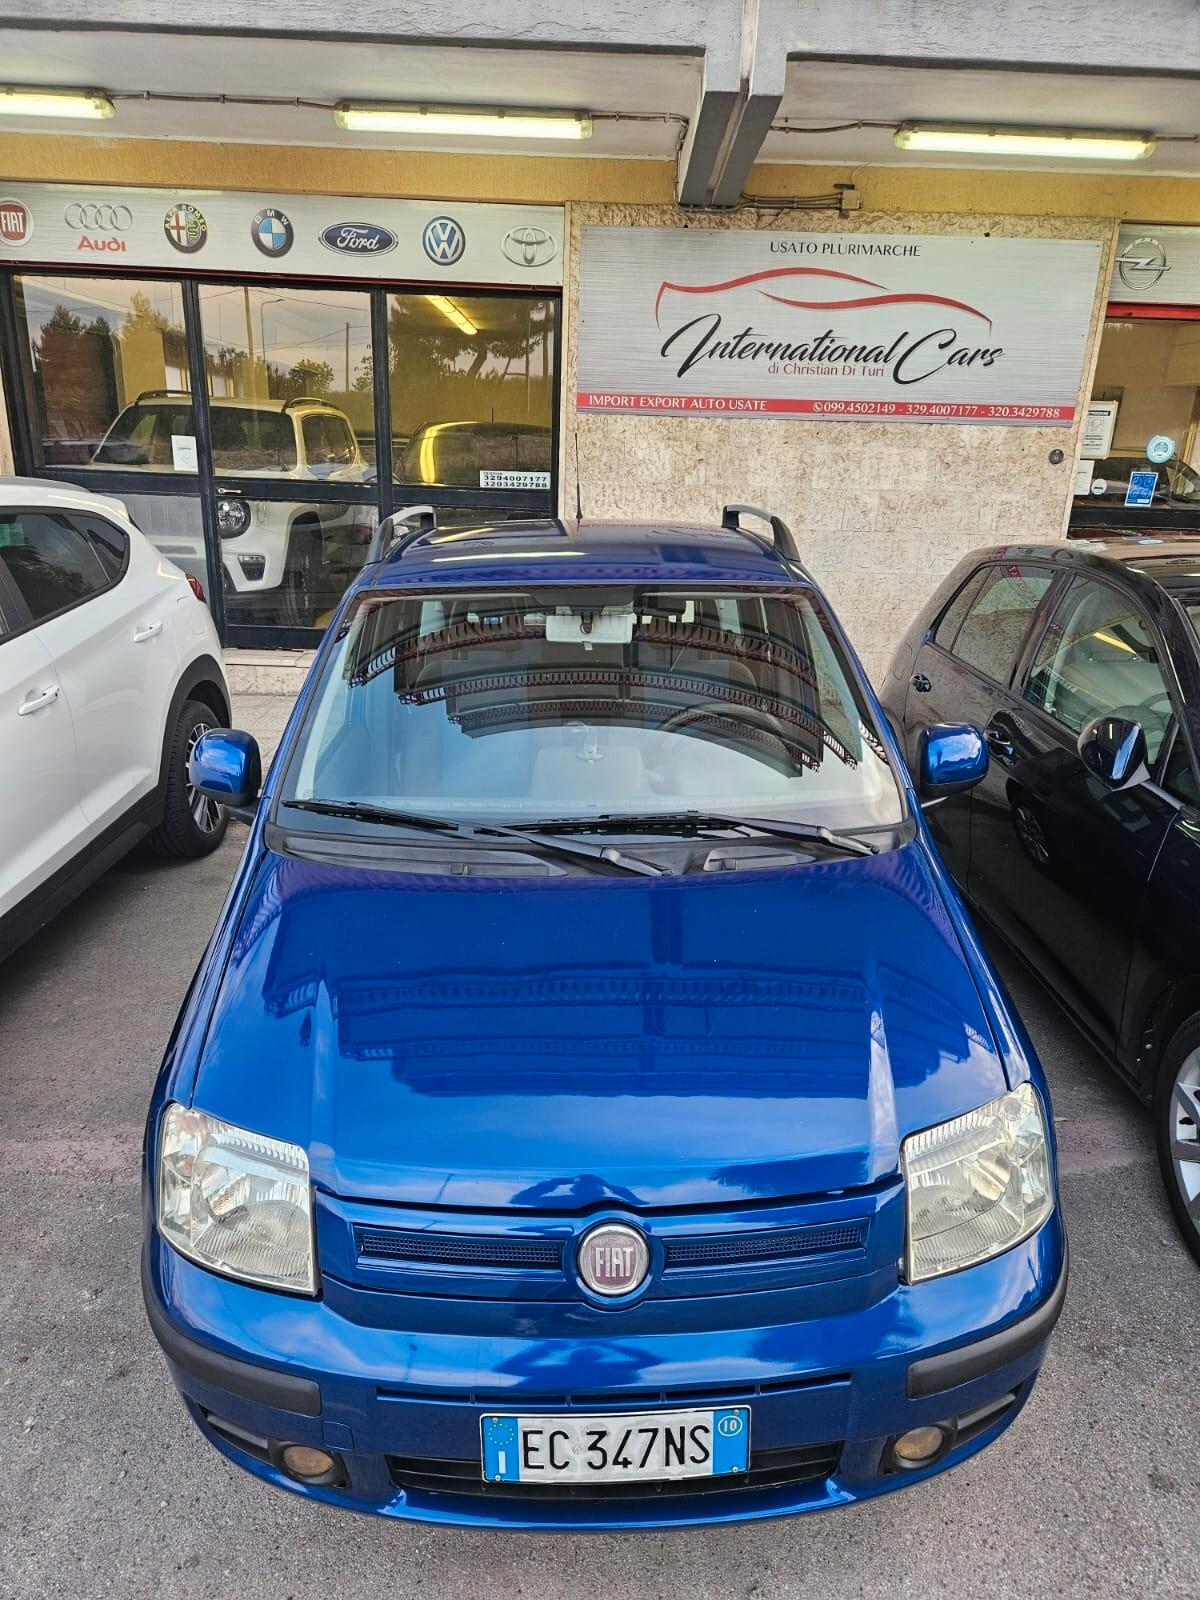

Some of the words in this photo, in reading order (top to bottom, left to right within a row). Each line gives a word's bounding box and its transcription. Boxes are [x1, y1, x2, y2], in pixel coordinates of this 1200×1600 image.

[0, 211, 24, 233] FIAT
[181, 204, 207, 231] ROMEO
[254, 209, 290, 226] BMW
[77, 235, 127, 252] Audi
[337, 227, 380, 250] Ford
[769, 241, 818, 255] USATO
[822, 242, 922, 258] PLURIMARCHE
[661, 313, 911, 379] International
[892, 328, 1006, 386] Cars
[767, 363, 780, 376] di
[783, 363, 838, 377] Christian
[842, 364, 857, 377] Di
[859, 365, 885, 378] Turi
[589, 395, 637, 408] IMPORT
[640, 396, 687, 409] EXPORT
[690, 398, 726, 410] AUTO
[728, 400, 768, 412] USATE
[823, 402, 896, 415] 099.4502149
[906, 404, 978, 417] 329.4007177
[988, 406, 1061, 419] 320.3429788
[595, 1247, 634, 1278] FIAT
[720, 1419, 738, 1432] 10
[522, 1429, 570, 1470] EC
[586, 1425, 711, 1469] 347NS
